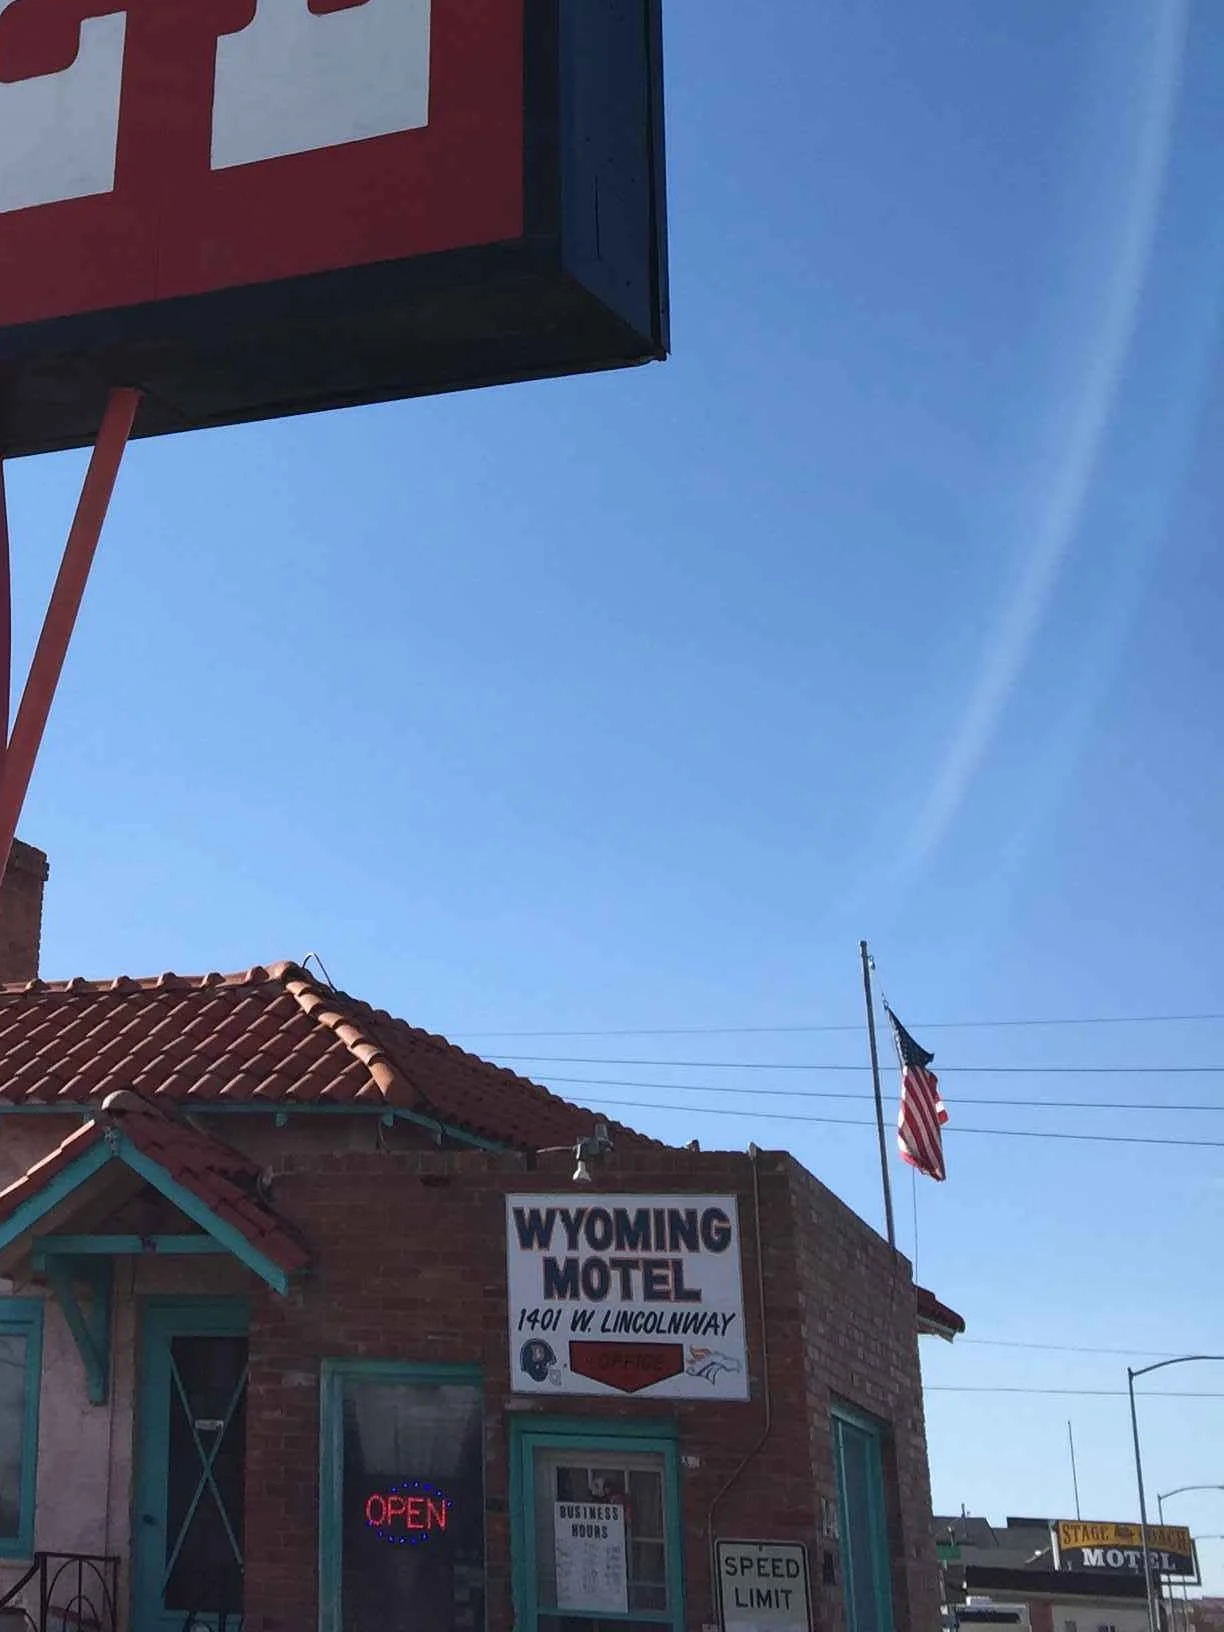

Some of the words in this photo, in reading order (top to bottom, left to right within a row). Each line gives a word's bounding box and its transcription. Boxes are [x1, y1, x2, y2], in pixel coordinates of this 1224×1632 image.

[512, 1206, 732, 1253] WYOMING
[542, 1256, 702, 1303] MOTEL
[517, 1308, 562, 1332] 1401
[570, 1309, 592, 1333] W.
[600, 1310, 736, 1336] LINCOLNWAY
[366, 1494, 447, 1530] OPEN
[559, 1505, 619, 1520] BUSINESS
[571, 1524, 608, 1539] HOURS
[725, 1557, 800, 1578] SPEED
[1081, 1548, 1176, 1570] MOTEL
[735, 1588, 793, 1610] LIMIT
